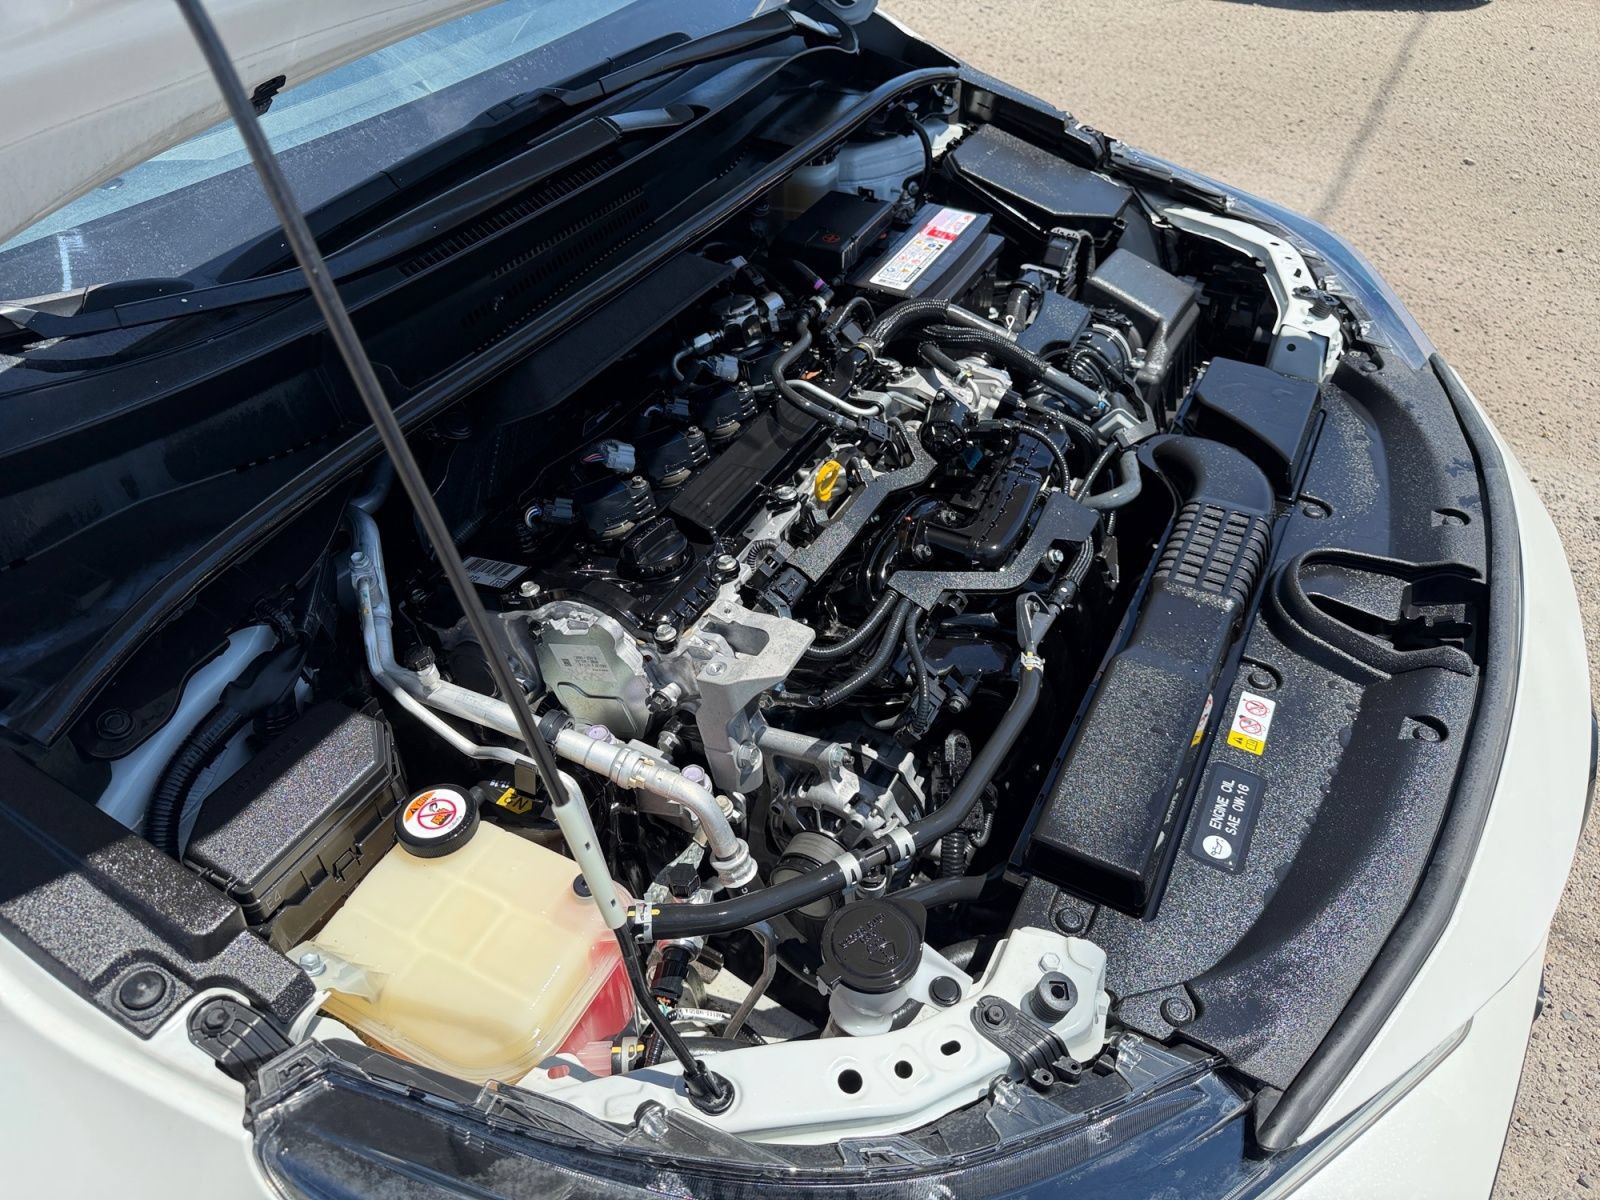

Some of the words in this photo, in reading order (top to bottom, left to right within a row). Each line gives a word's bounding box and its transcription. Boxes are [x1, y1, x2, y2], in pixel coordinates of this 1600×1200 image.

[1209, 795, 1229, 830] ENGINE
[1221, 780, 1235, 793] OIL
[1232, 783, 1250, 812] 0W-16
[1225, 814, 1241, 836] SAE
